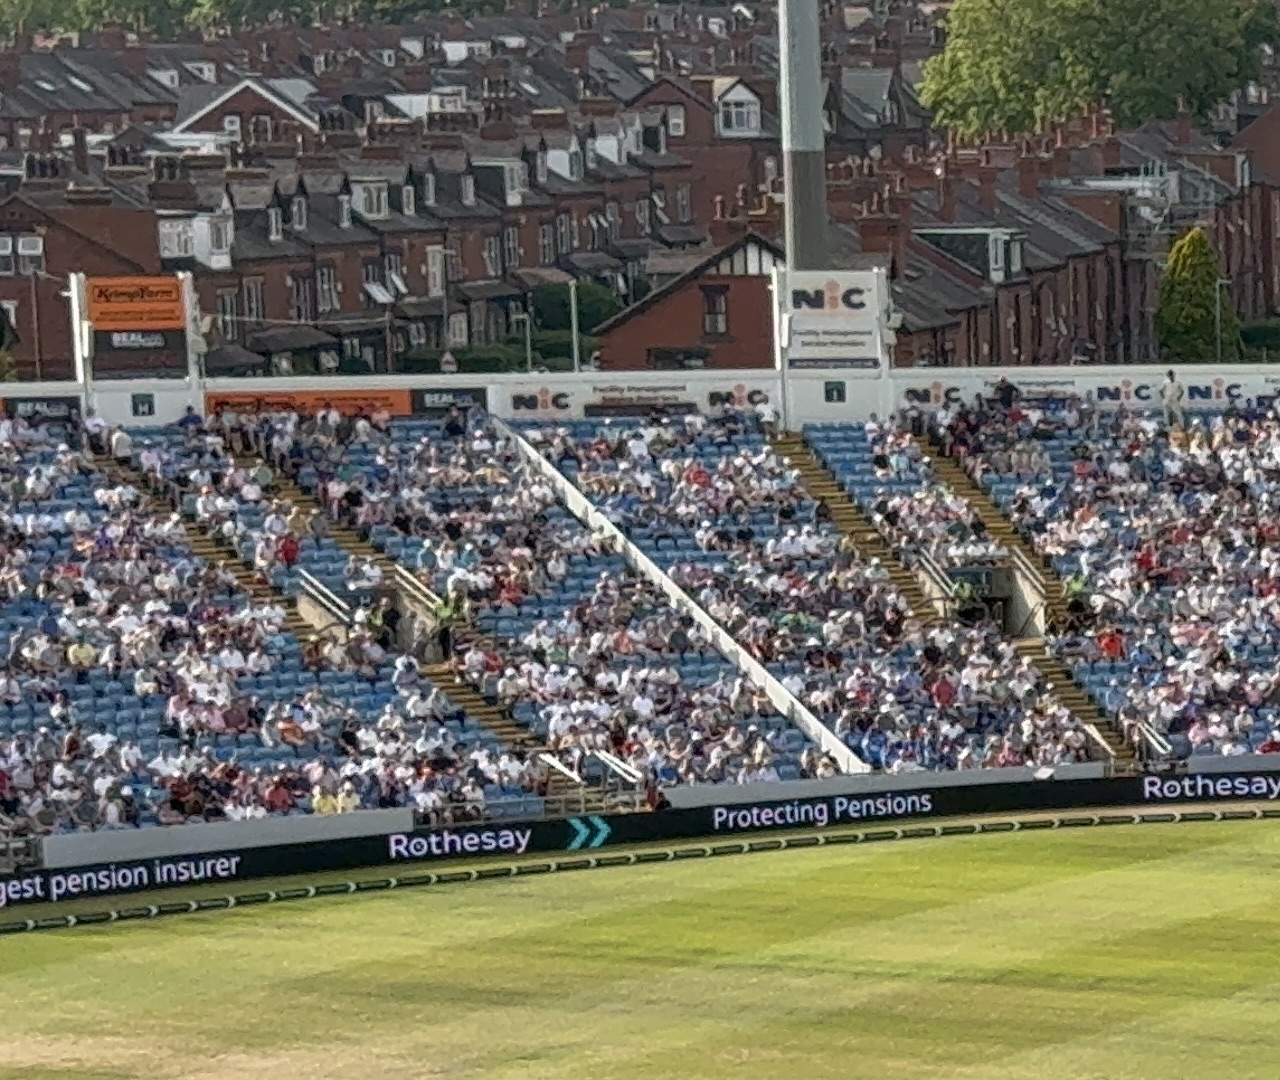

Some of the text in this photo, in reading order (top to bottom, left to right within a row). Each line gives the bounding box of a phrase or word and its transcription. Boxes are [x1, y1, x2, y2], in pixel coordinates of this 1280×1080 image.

[713, 793, 933, 830] Protecting Pensions
[388, 826, 532, 860] Rothesay
[51, 864, 148, 901] pension
[154, 856, 241, 883] insurer
